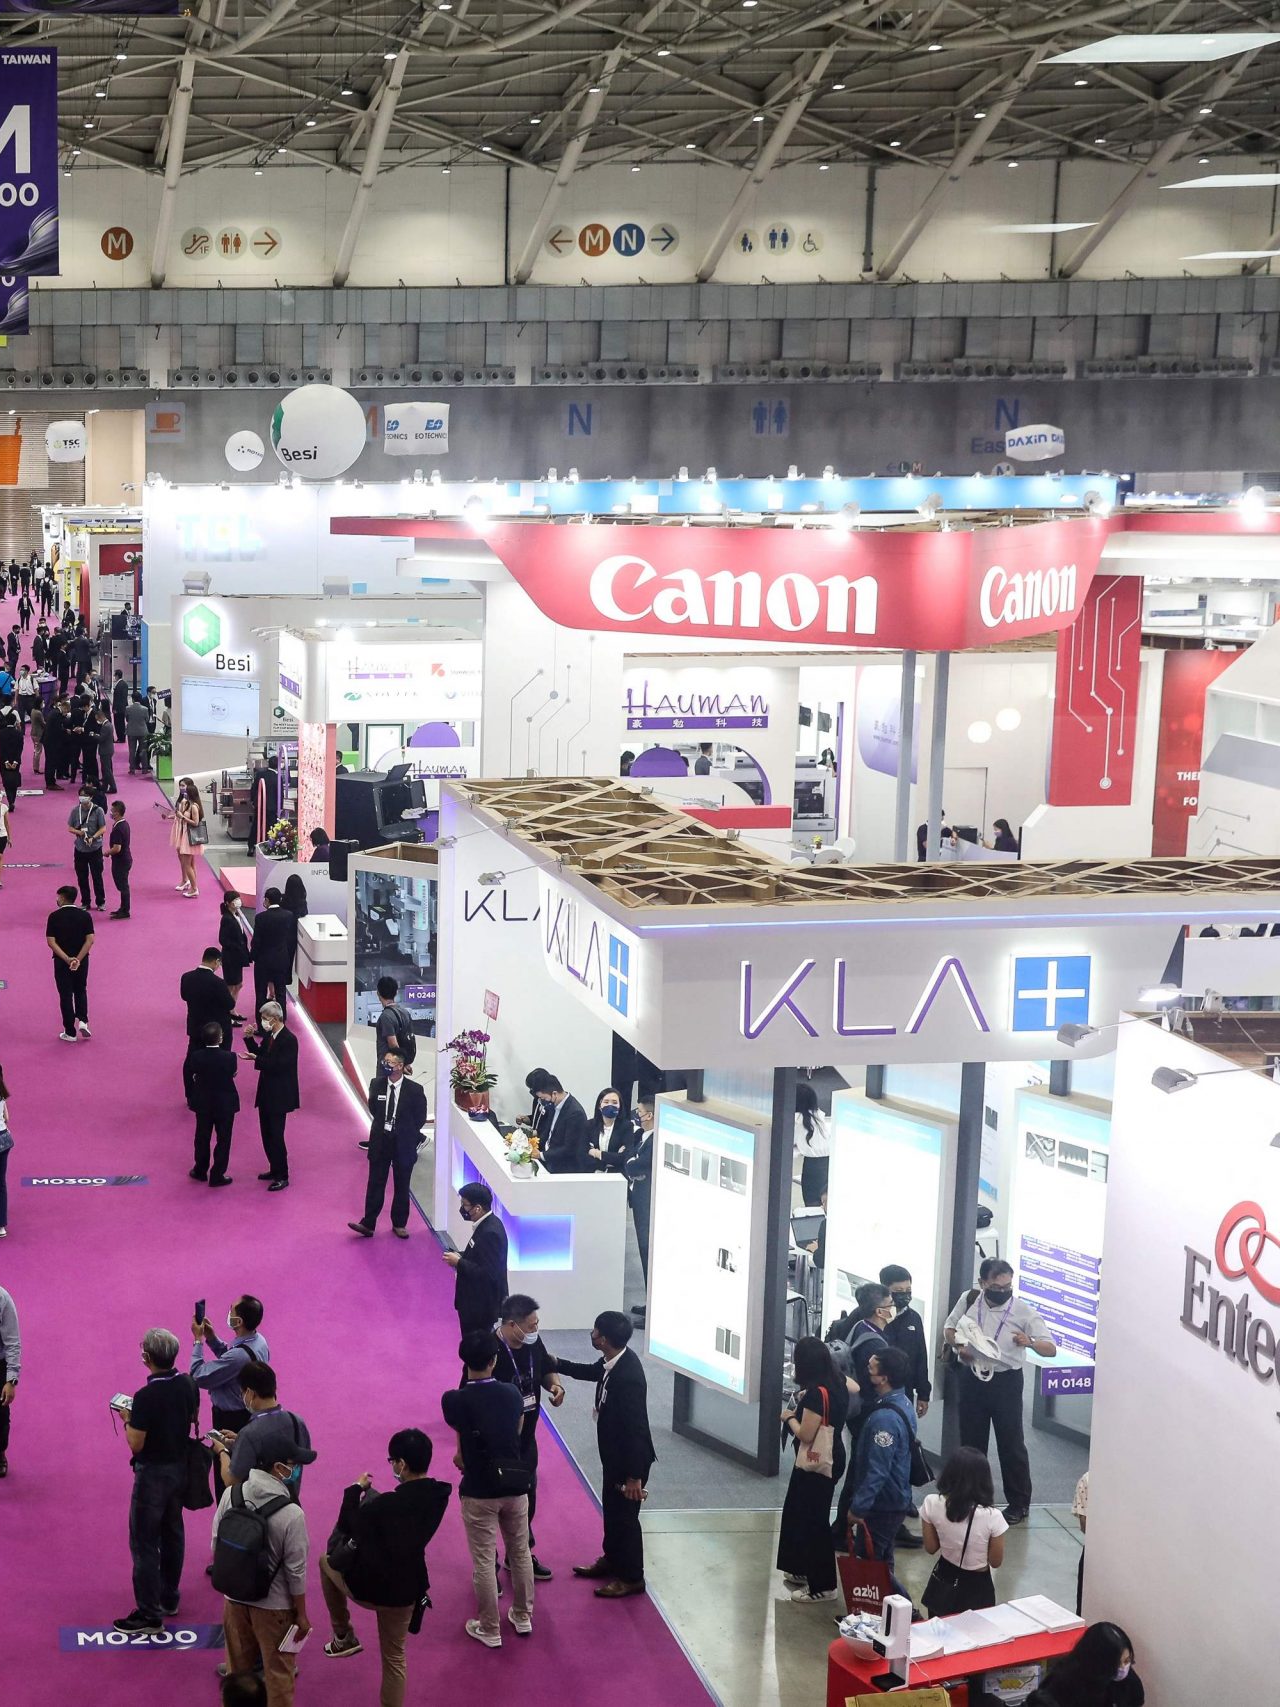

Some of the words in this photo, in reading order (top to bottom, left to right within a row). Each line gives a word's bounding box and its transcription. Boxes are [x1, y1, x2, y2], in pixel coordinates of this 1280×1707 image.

[1, 54, 51, 65] TAIWAN
[106, 233, 127, 255] M
[584, 229, 604, 252] M
[621, 229, 638, 252] N
[568, 404, 593, 437] N
[280, 446, 318, 462] Besi
[971, 437, 1006, 454] Eas
[589, 555, 879, 635] Canon
[980, 563, 1077, 628] Canon
[216, 653, 252, 672] Besi
[464, 889, 541, 922] KL
[739, 954, 991, 1040] KLA
[32, 1177, 107, 1187] M0300
[1047, 1378, 1058, 1389] M
[1061, 1377, 1092, 1389] 0148
[852, 1585, 880, 1599] azbil
[77, 1629, 197, 1646] M0200
